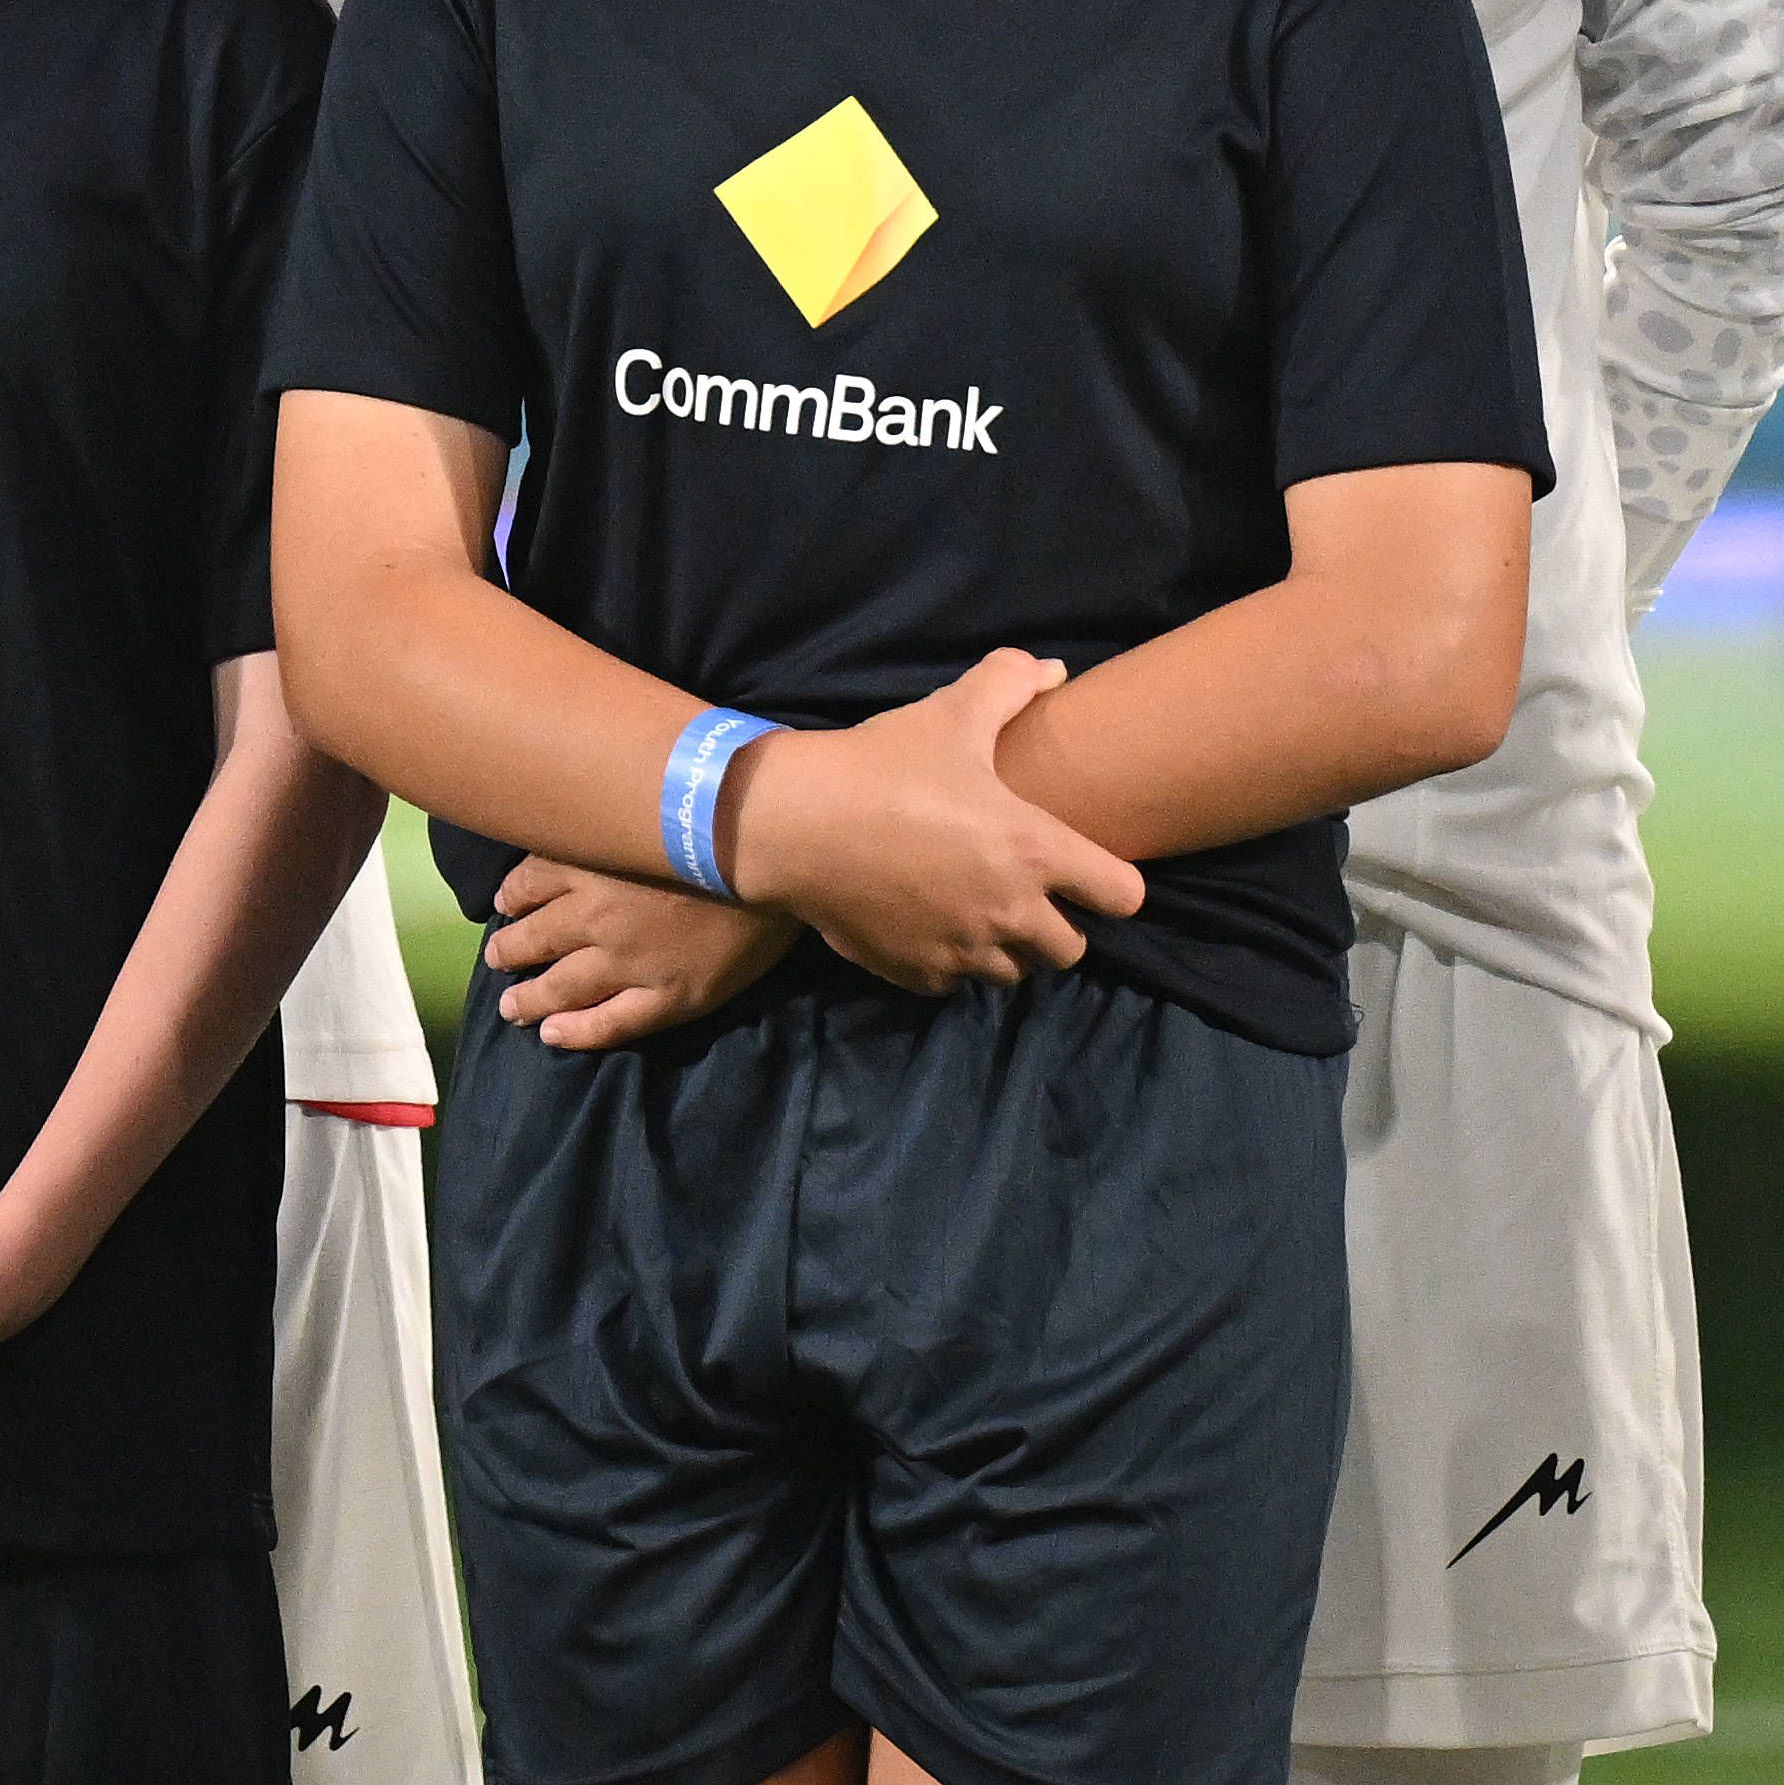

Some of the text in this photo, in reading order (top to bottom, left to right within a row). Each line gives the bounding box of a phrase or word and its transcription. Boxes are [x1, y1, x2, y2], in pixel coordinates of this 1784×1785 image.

[615, 348, 1004, 455] CommBank
[677, 718, 746, 890] Youth Programm
